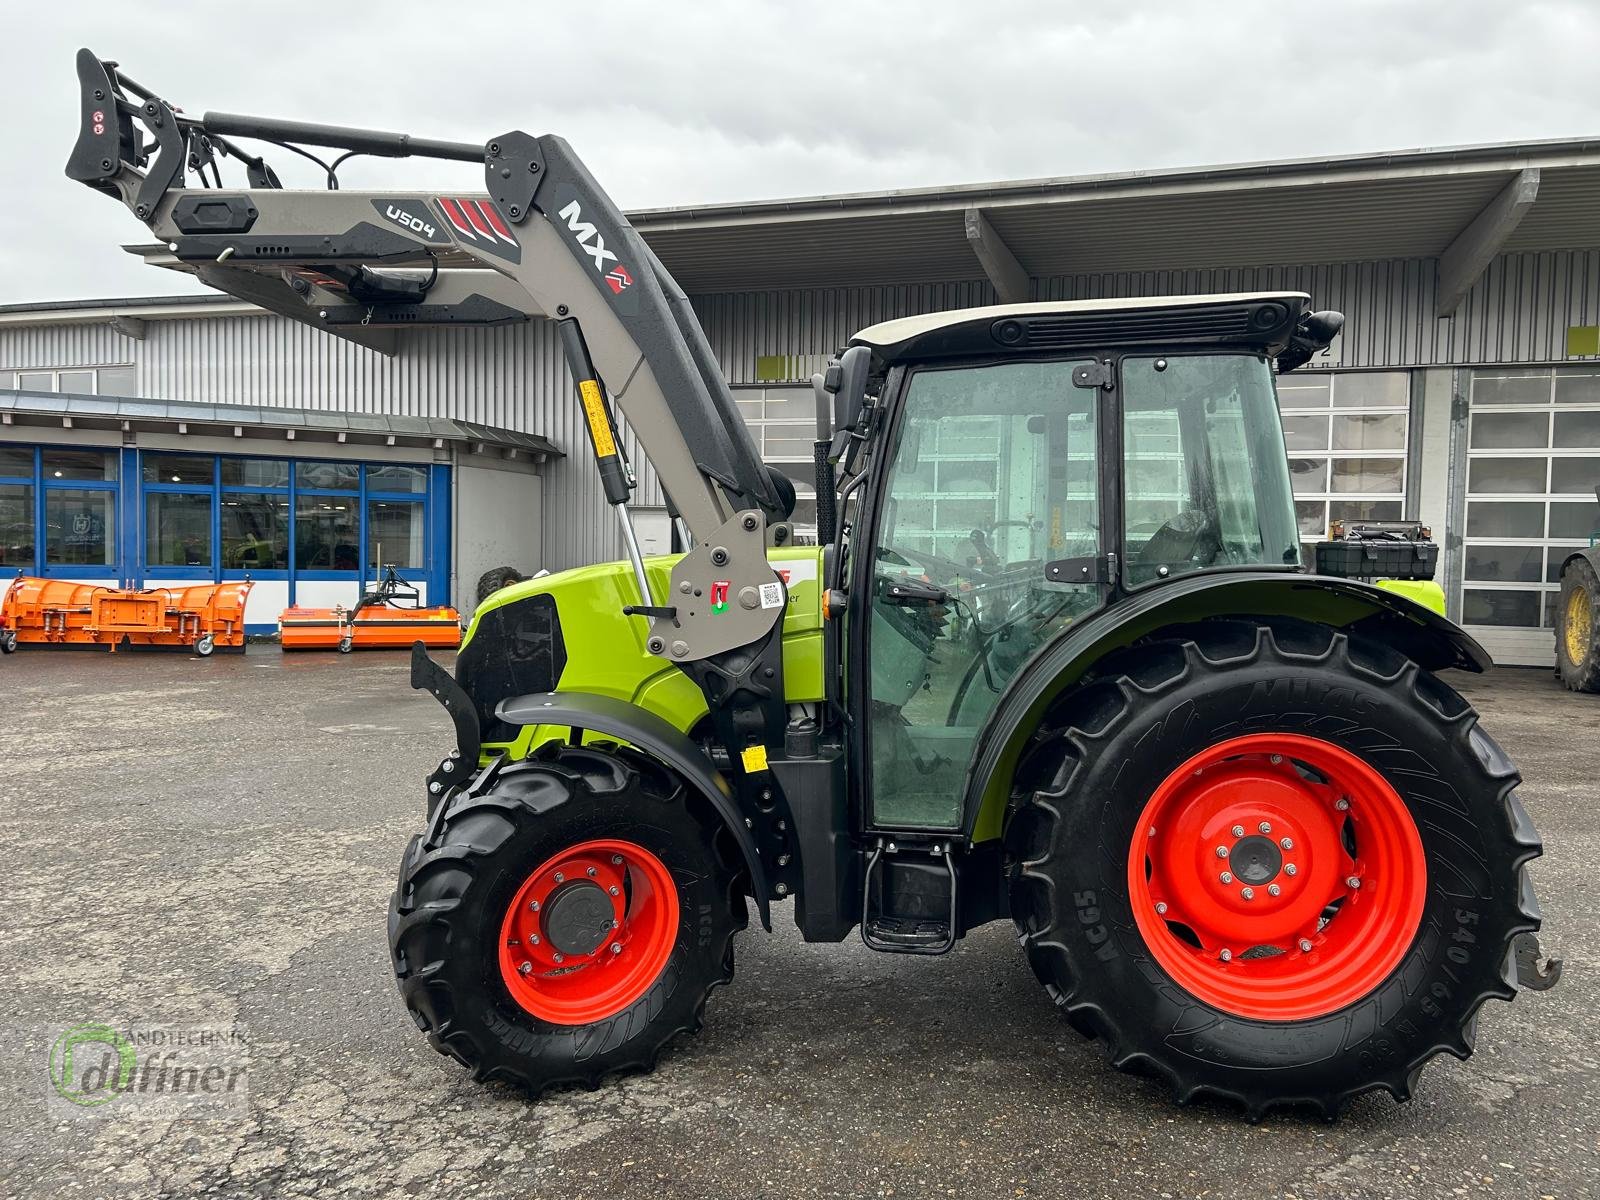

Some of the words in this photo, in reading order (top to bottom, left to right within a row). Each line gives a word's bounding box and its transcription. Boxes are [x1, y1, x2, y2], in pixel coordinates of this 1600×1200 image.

[386, 204, 436, 239] U504
[558, 199, 619, 273] MX
[1239, 677, 1380, 714] Mitas
